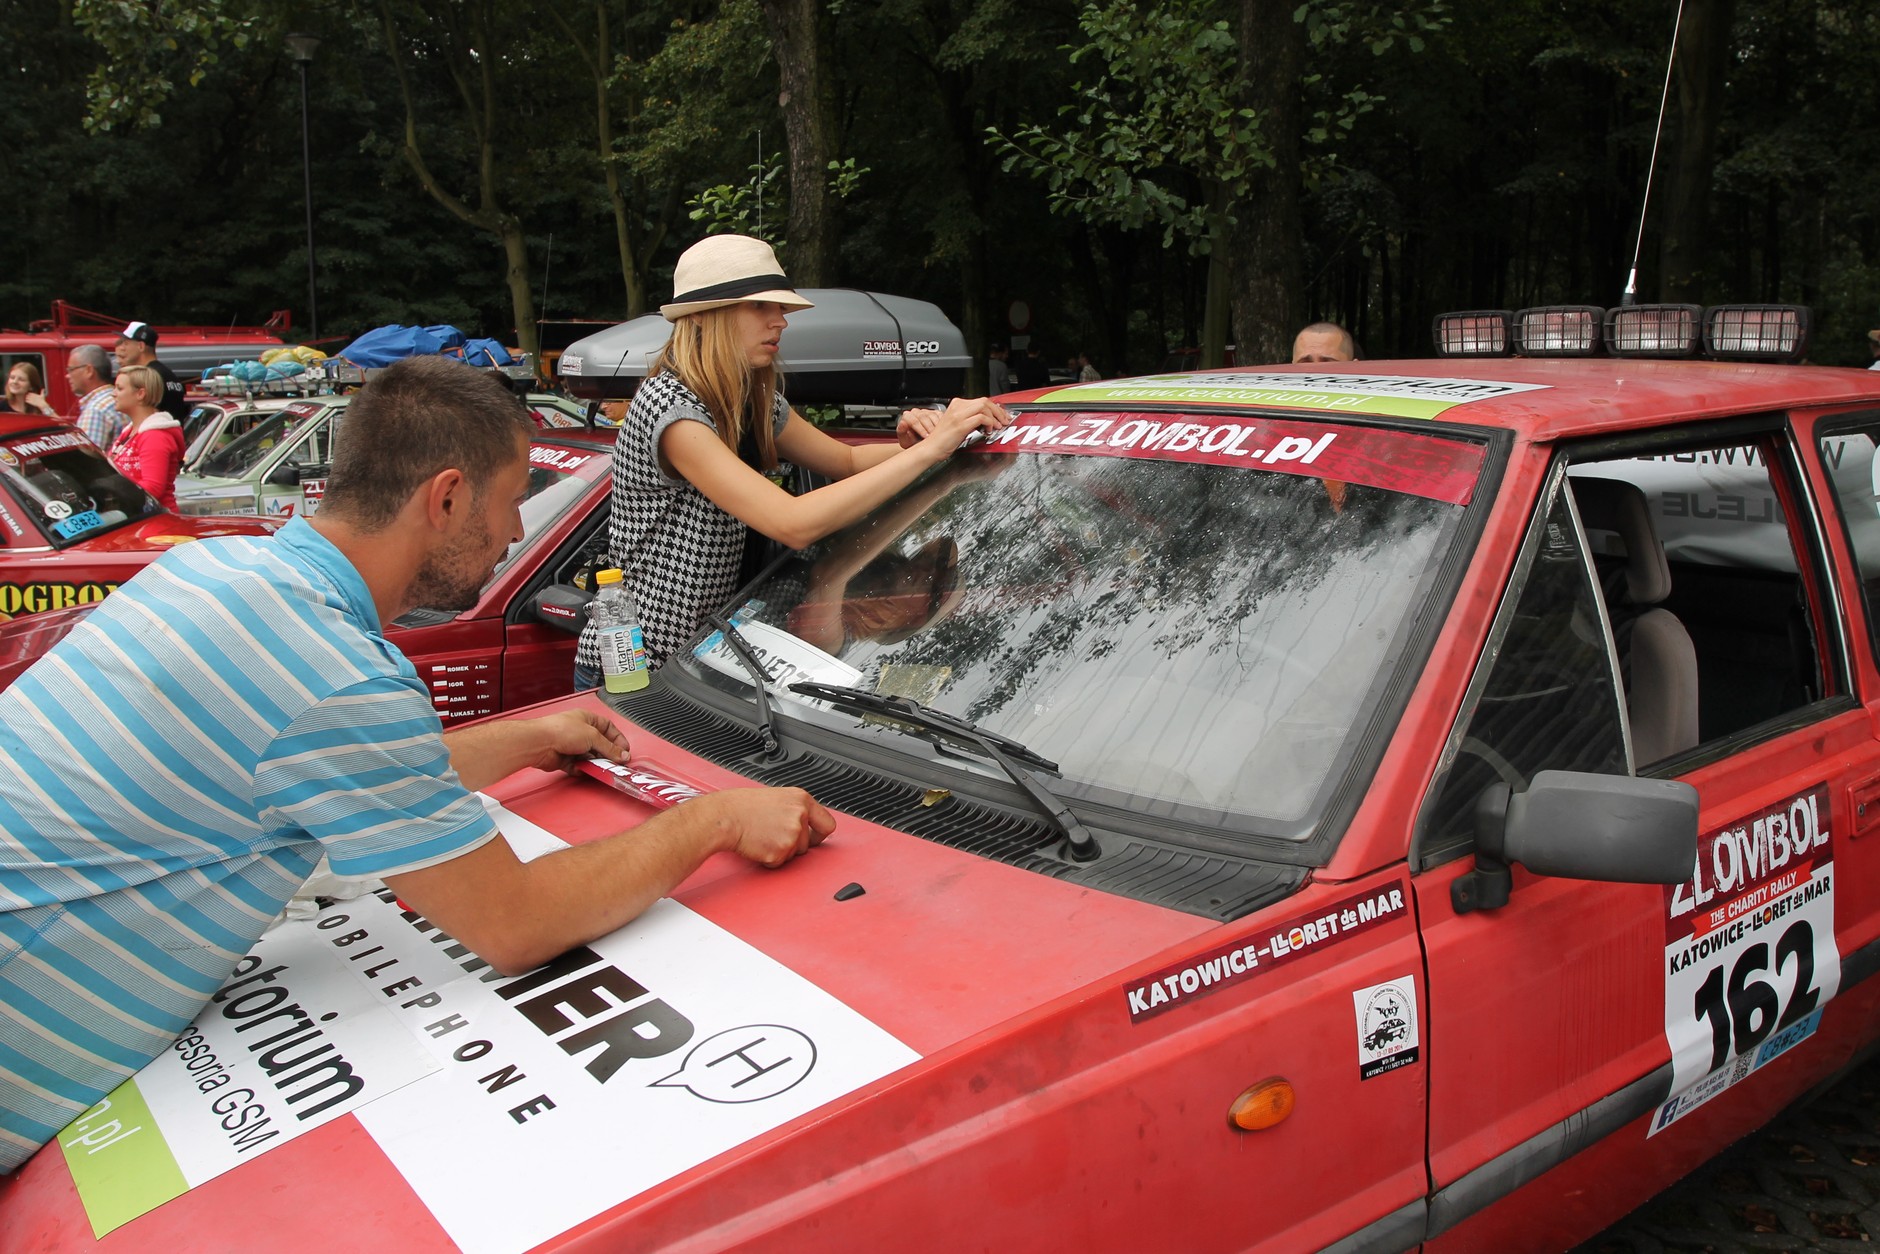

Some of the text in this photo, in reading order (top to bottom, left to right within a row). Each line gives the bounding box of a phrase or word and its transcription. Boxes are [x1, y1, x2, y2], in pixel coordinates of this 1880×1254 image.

[864, 342, 901, 350] ZLOMBOL
[906, 342, 939, 353] eco
[1107, 388, 1374, 408] www.teletorium.pl
[1206, 374, 1512, 393] teletorium
[1412, 388, 1484, 399] GSM
[984, 419, 1337, 464] ww.ZLOMBOL.pl
[48, 503, 69, 516] PL
[0, 584, 118, 613] OGRO
[614, 632, 628, 673] vitamin
[1340, 909, 1358, 930] de
[1359, 889, 1404, 923] MAR
[1710, 872, 1797, 927] THE CHARITY RALLY
[1794, 892, 1803, 910] de
[1805, 876, 1830, 903] MAR
[1694, 920, 1820, 1076] 162
[706, 1037, 793, 1088] H
[212, 1087, 280, 1154] GSM
